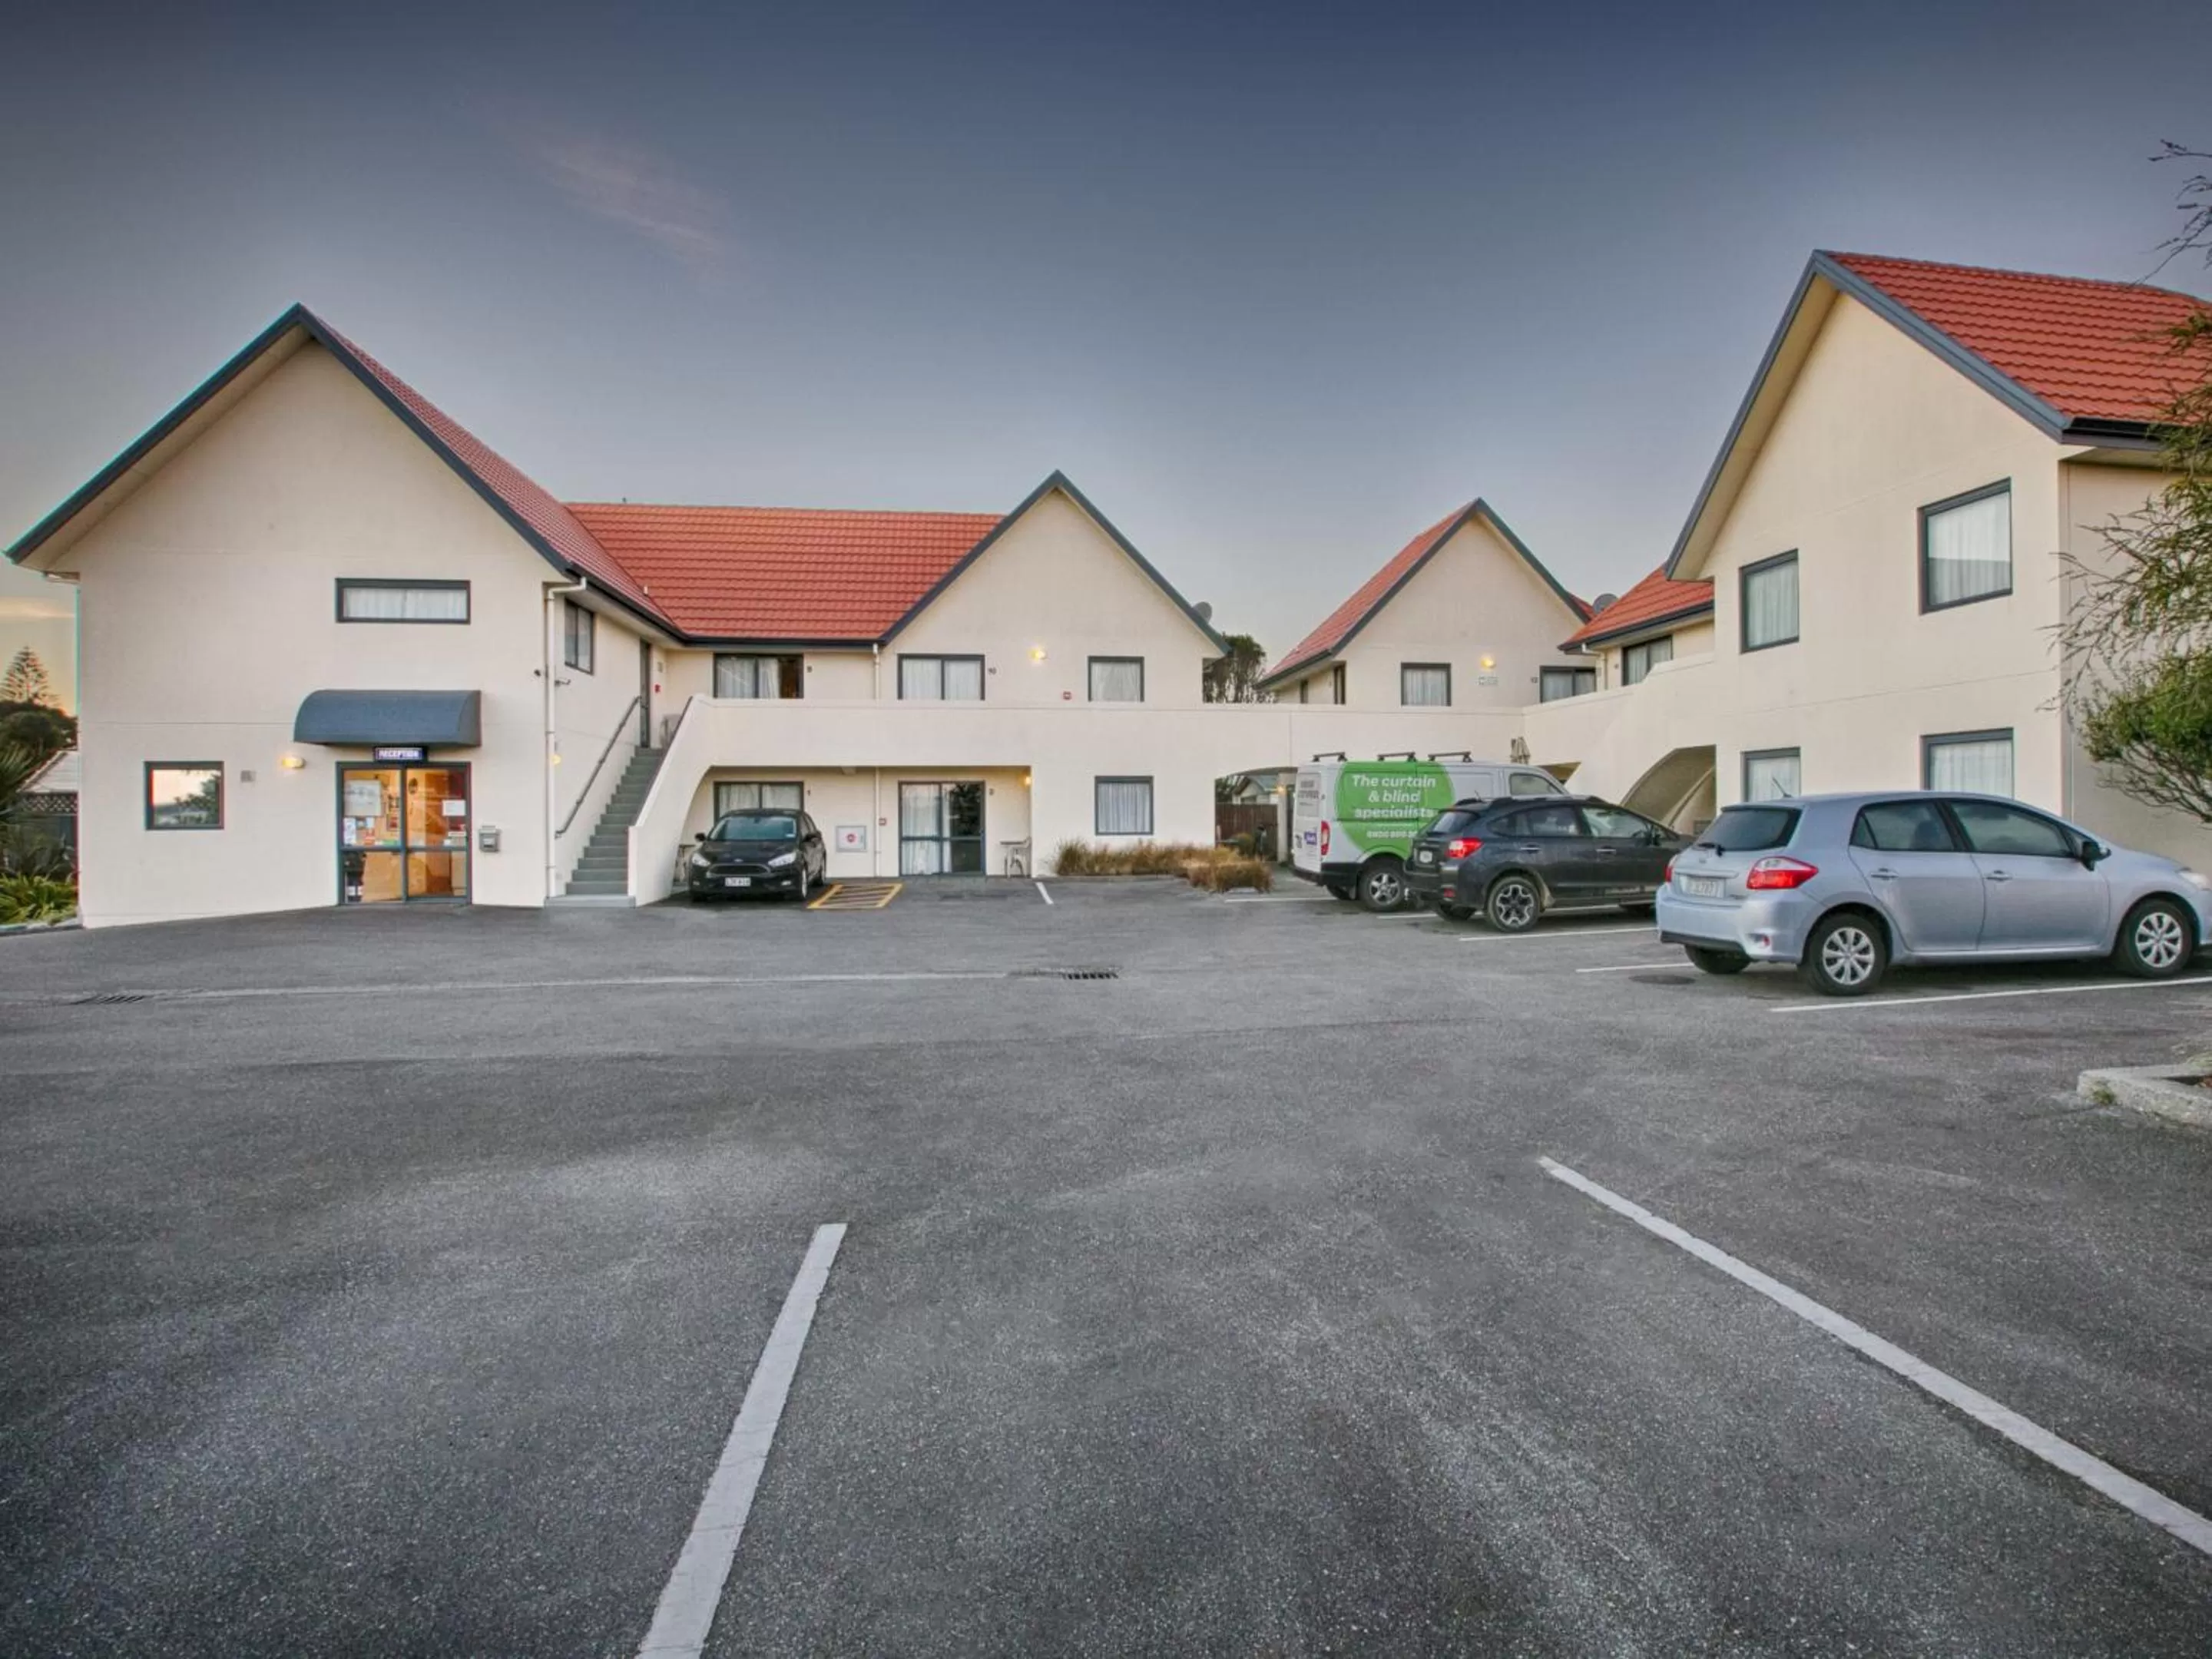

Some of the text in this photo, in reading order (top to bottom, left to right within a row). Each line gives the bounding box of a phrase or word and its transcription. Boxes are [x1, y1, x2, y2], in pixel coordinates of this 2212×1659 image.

[378, 750, 419, 760] RECEPTION
[1353, 774, 1435, 788] The curtain
[1368, 790, 1422, 803] & blind
[1354, 805, 1435, 820] specialists
